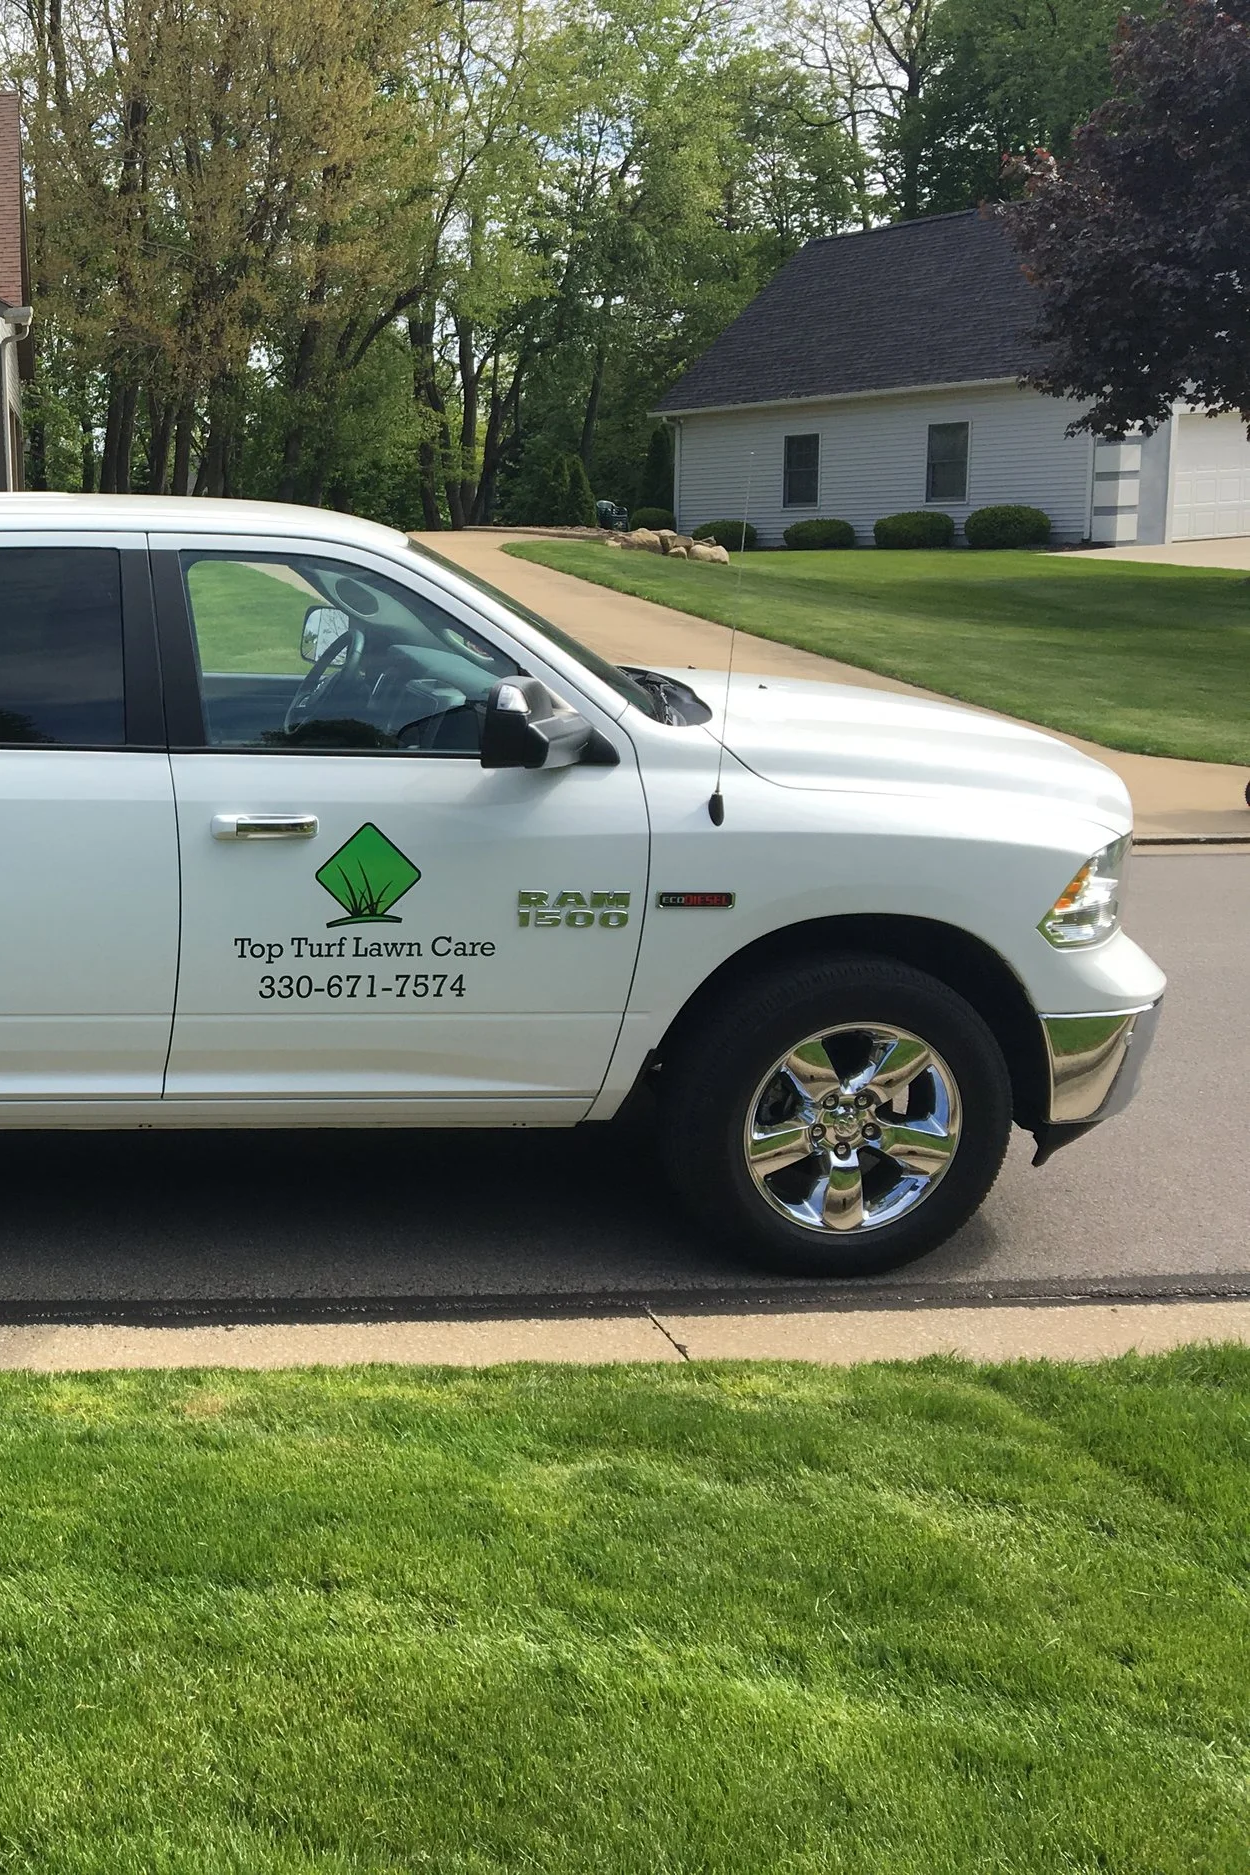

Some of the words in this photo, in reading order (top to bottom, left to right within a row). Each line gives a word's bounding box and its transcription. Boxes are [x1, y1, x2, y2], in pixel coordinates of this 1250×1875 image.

[518, 890, 631, 908] RAM
[518, 909, 629, 928] 1500
[234, 937, 284, 964] Top
[291, 936, 347, 958] Turf
[352, 936, 423, 957] Lawn
[431, 935, 496, 957] Care
[258, 974, 467, 999] 330-671-7574
